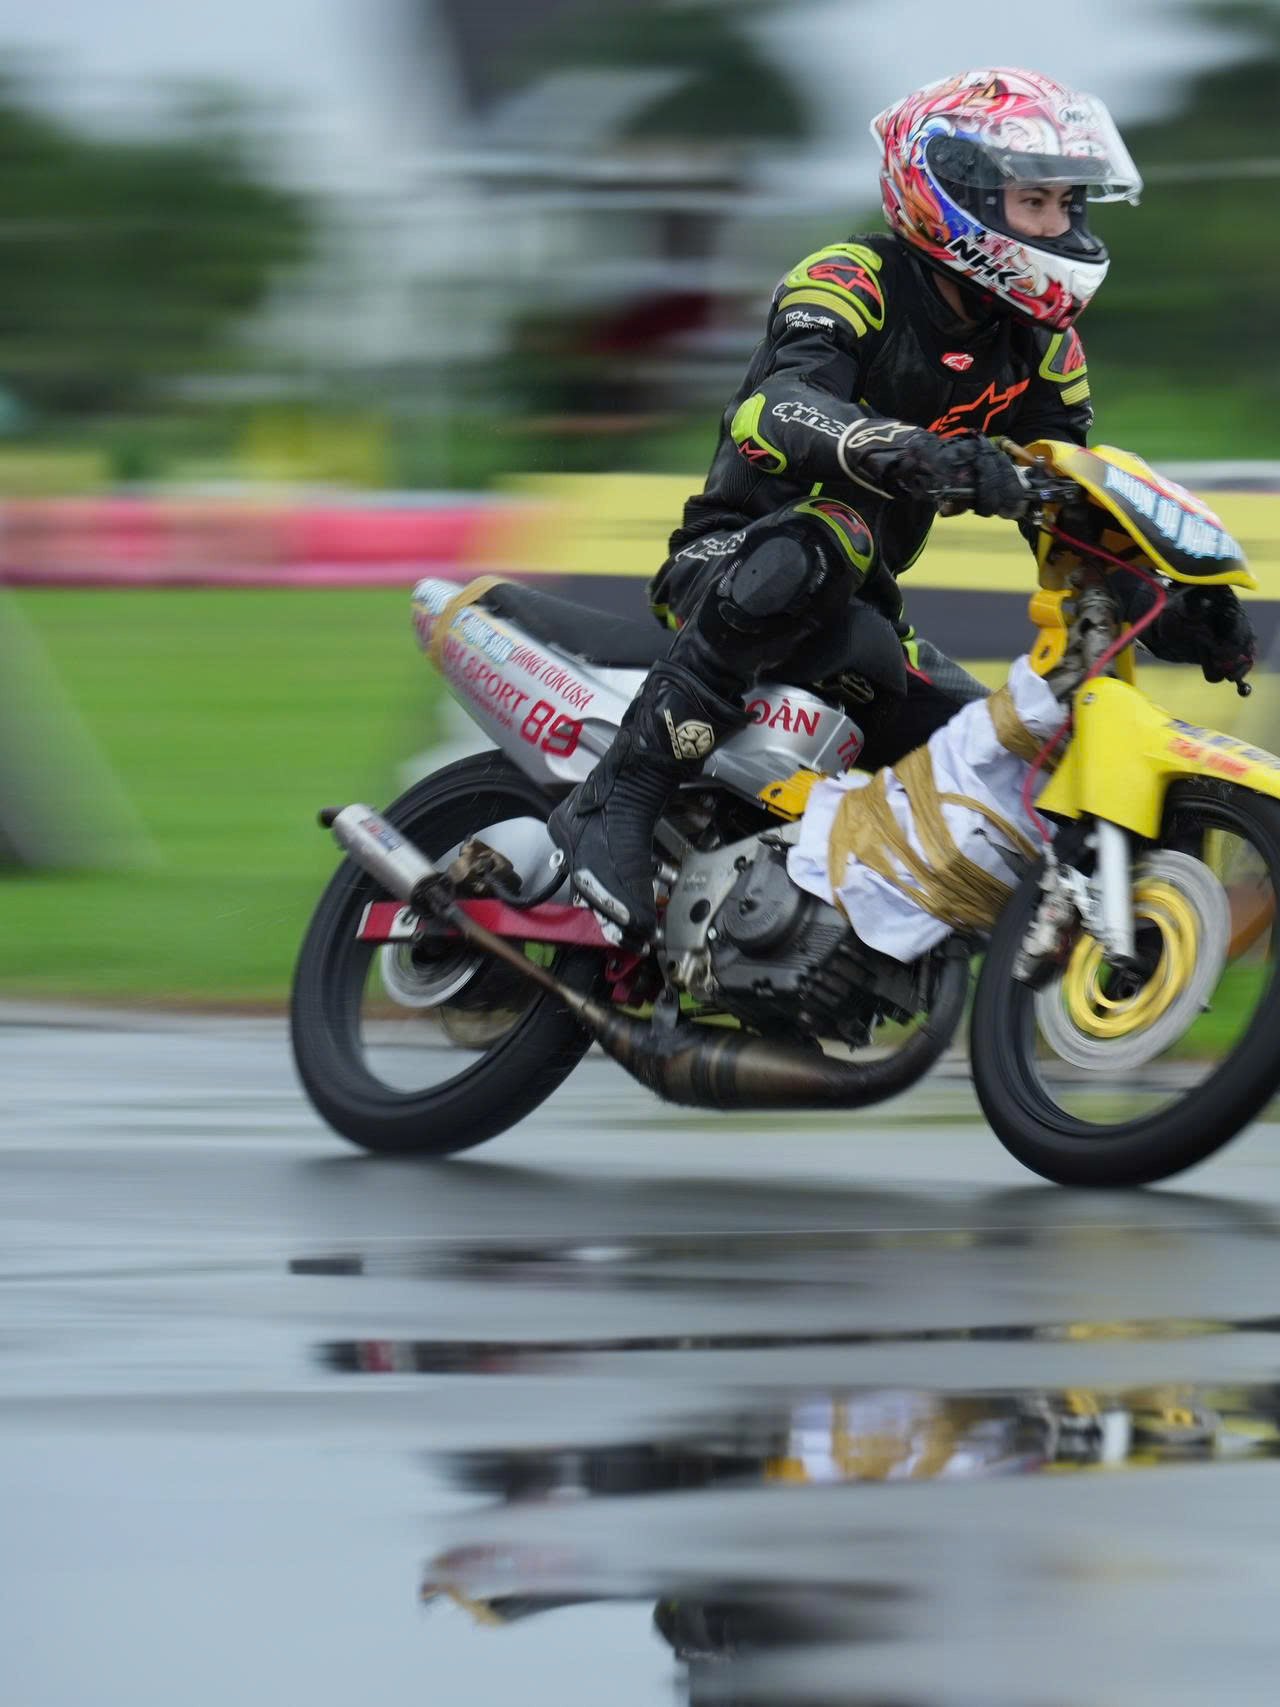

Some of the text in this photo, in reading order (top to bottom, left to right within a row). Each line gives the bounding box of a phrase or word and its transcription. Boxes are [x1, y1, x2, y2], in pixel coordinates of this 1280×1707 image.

[944, 235, 1031, 292] NHK
[463, 656, 529, 713] SPORT
[520, 699, 583, 758] 89
[561, 681, 595, 712] USA
